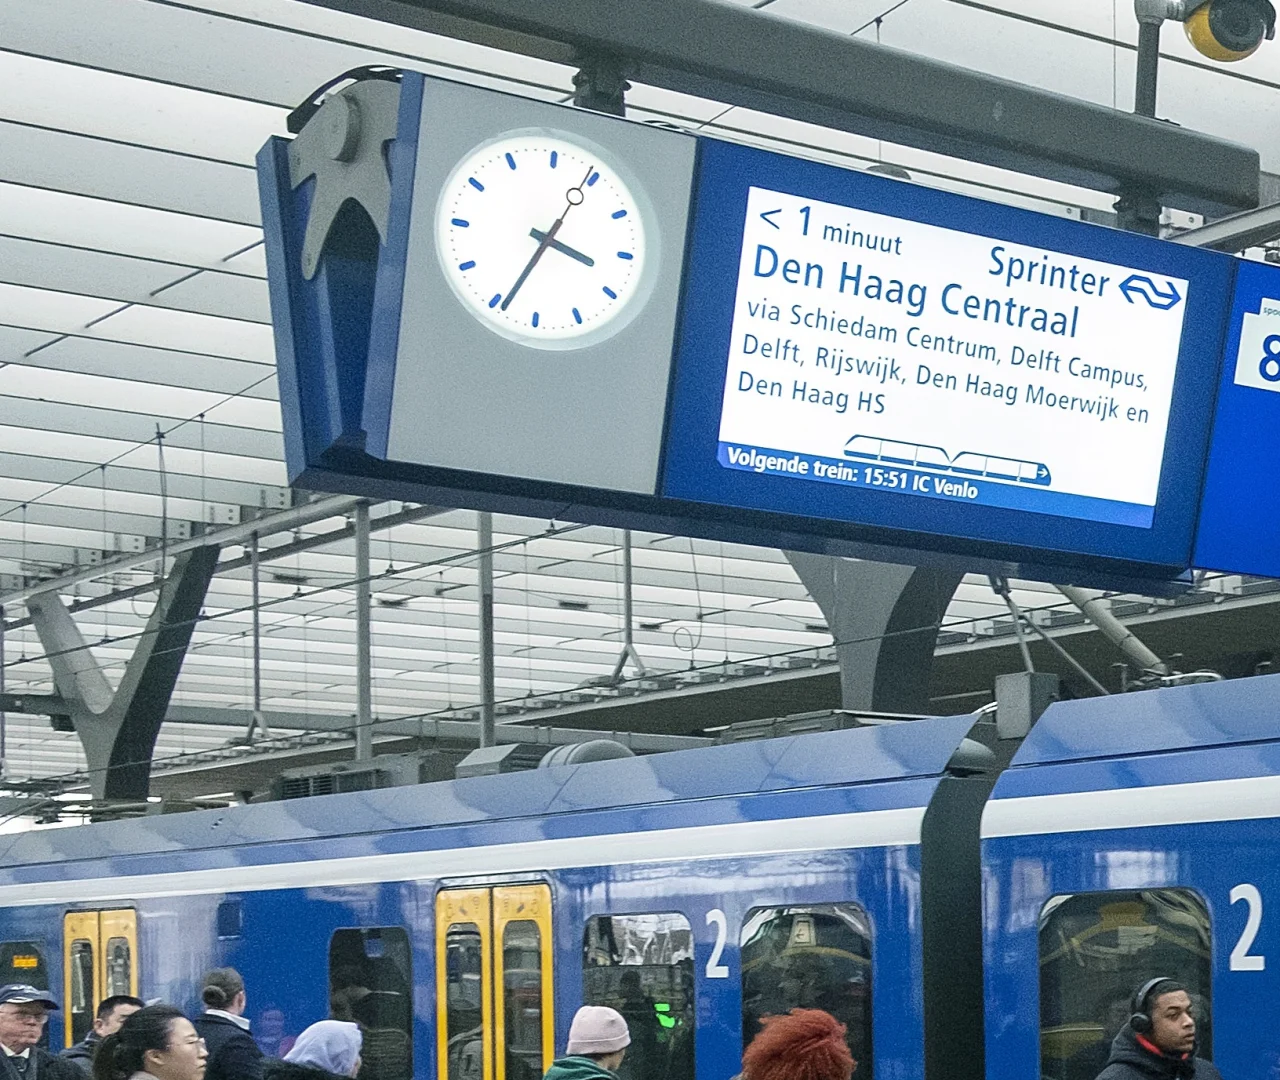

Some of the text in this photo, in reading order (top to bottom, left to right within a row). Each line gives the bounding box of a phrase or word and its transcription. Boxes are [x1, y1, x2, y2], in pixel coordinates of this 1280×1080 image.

[799, 205, 811, 236] 1
[823, 223, 903, 256] minuut
[753, 244, 1080, 338] Den Haag Centraal
[988, 246, 1110, 297] Sprinter
[742, 333, 1150, 424] Delft, Rijswijk, Den Haag Moerwijk en
[747, 297, 1149, 392] via Schiedam Centrum, Delft Campus,
[737, 370, 886, 414] Den Haag HS
[727, 446, 979, 499] Volgende trein: 15:51 IC Venlo
[705, 908, 730, 979] 2
[1229, 883, 1267, 972] 2
